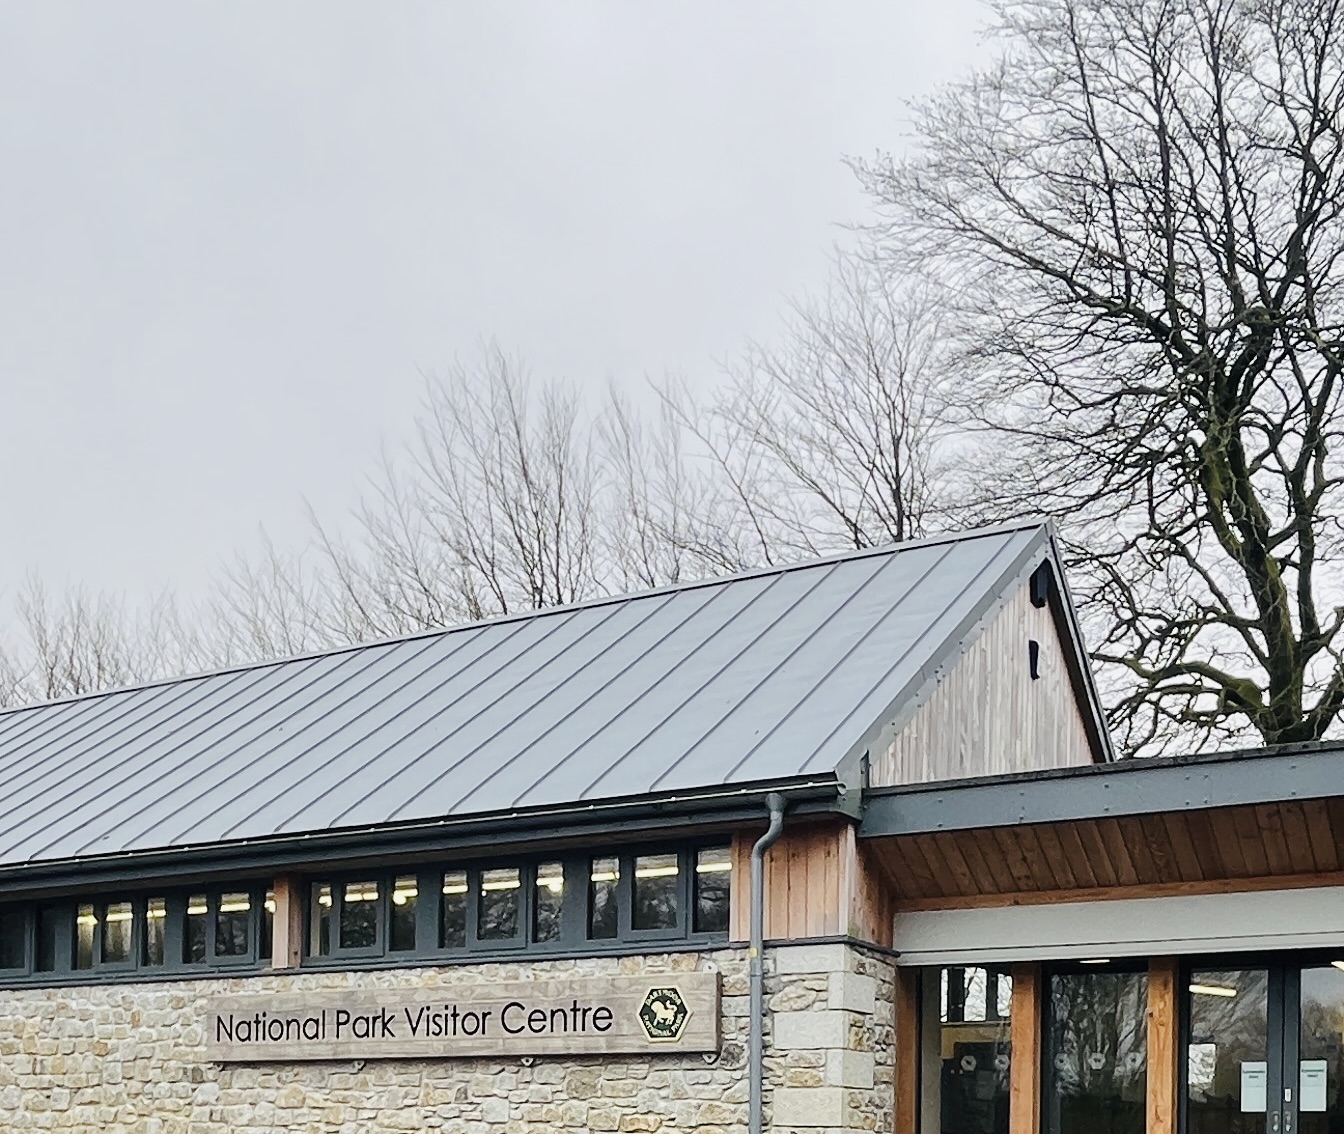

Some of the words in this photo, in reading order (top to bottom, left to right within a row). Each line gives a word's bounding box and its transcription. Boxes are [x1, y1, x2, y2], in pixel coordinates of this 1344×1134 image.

[215, 1009, 326, 1043] National
[335, 1007, 396, 1040] Park
[404, 1004, 492, 1037] Visitor
[500, 999, 614, 1034] Centre
